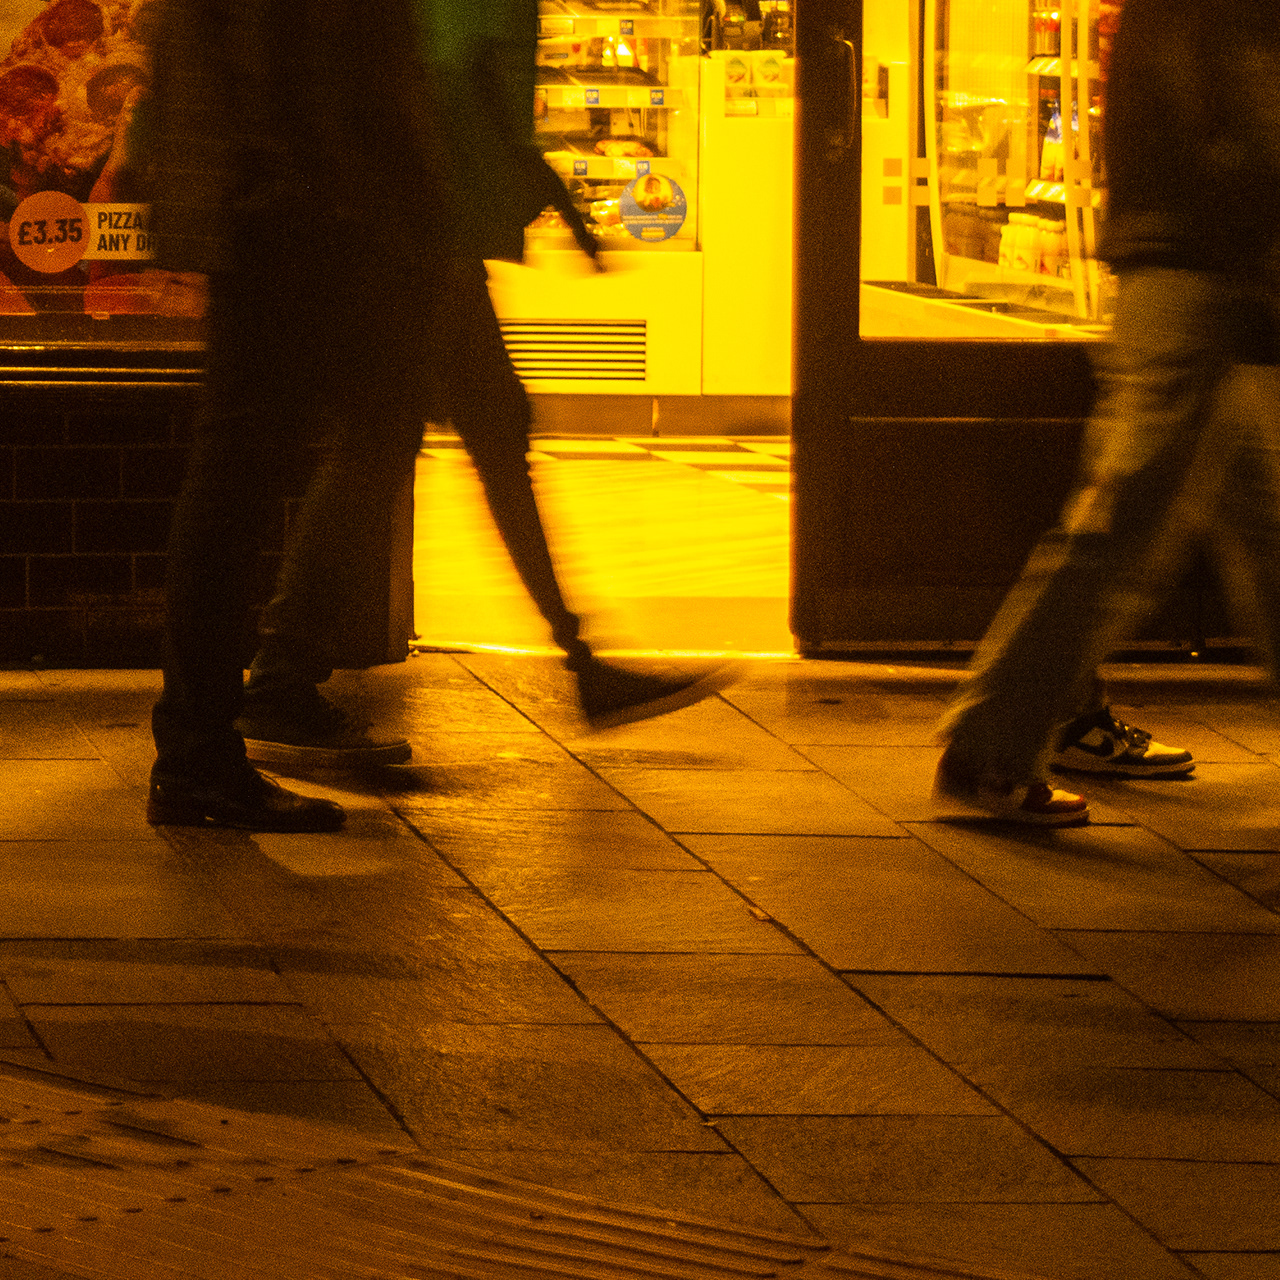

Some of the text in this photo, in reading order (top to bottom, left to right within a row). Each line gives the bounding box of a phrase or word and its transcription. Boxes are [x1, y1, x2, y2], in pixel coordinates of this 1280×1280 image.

[18, 212, 144, 245] £3.35 PIZZA
[97, 233, 131, 251] ANY
